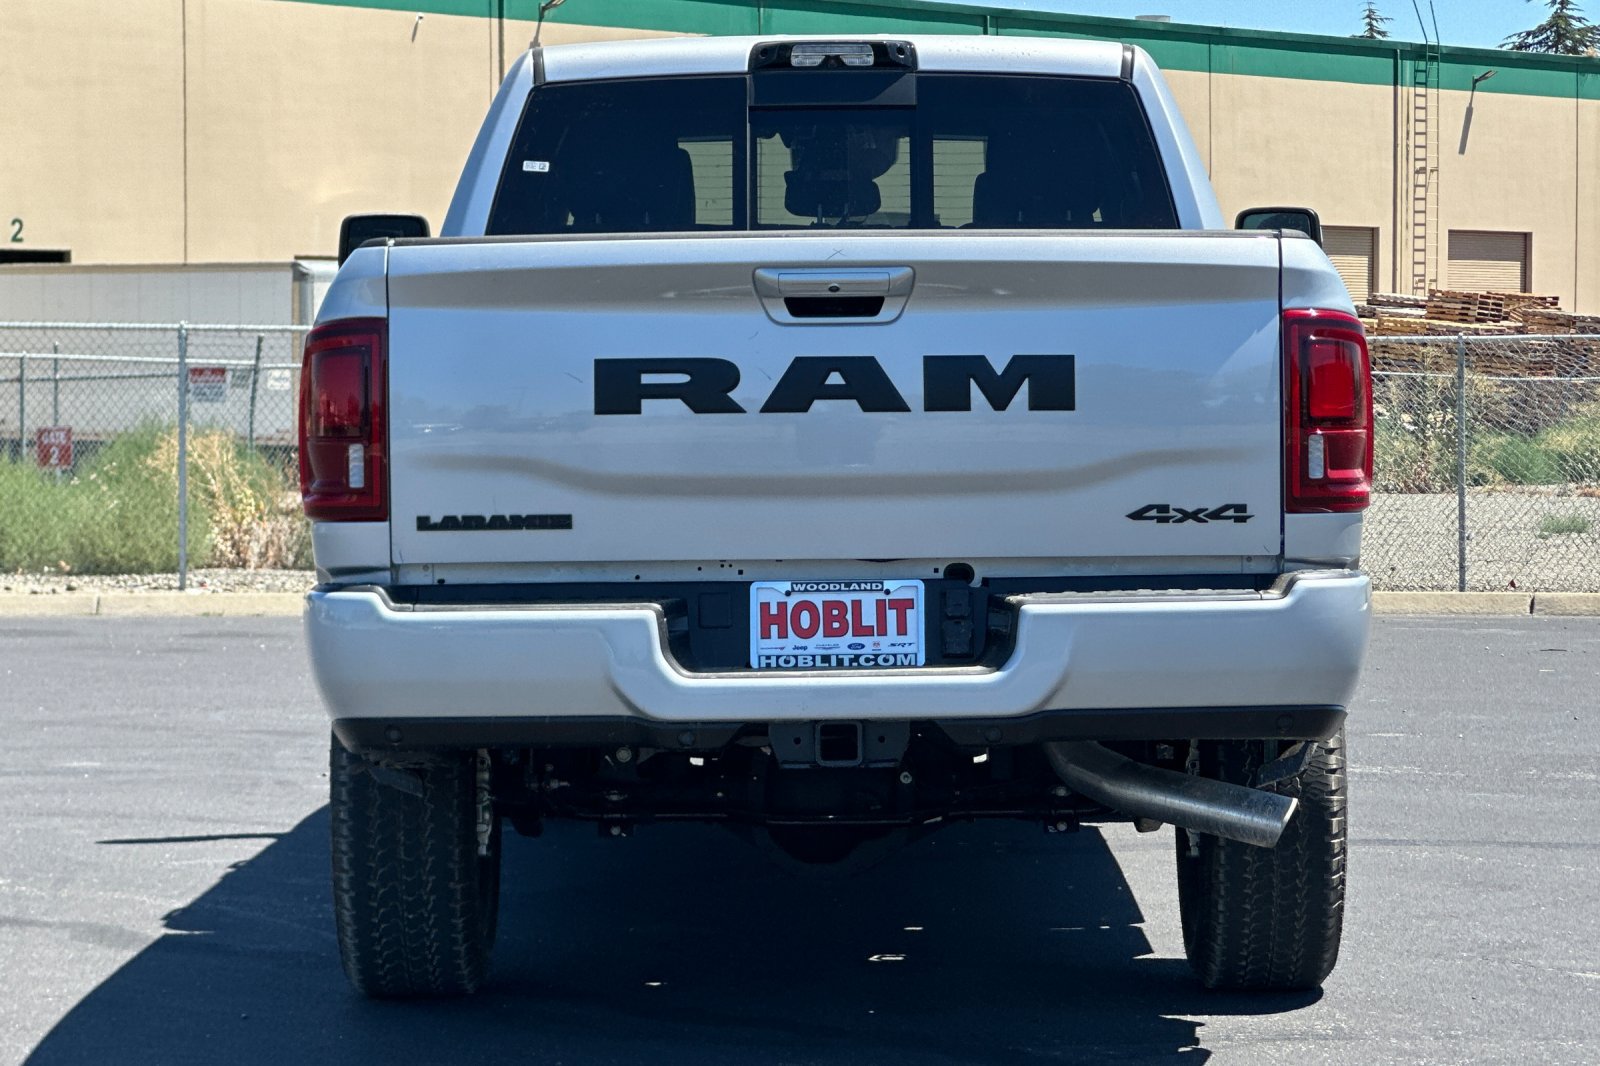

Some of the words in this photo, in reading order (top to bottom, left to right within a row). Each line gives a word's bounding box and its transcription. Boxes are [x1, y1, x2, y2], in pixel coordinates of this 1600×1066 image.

[11, 218, 24, 243] 2
[594, 354, 1076, 415] RAM
[50, 446, 60, 465] 2
[416, 514, 573, 531] LARAMIE
[1125, 503, 1255, 524] 4x4
[792, 582, 882, 592] WOODLAND
[759, 599, 915, 640] HOBLIT
[760, 653, 916, 668] HOBLIT.COM
